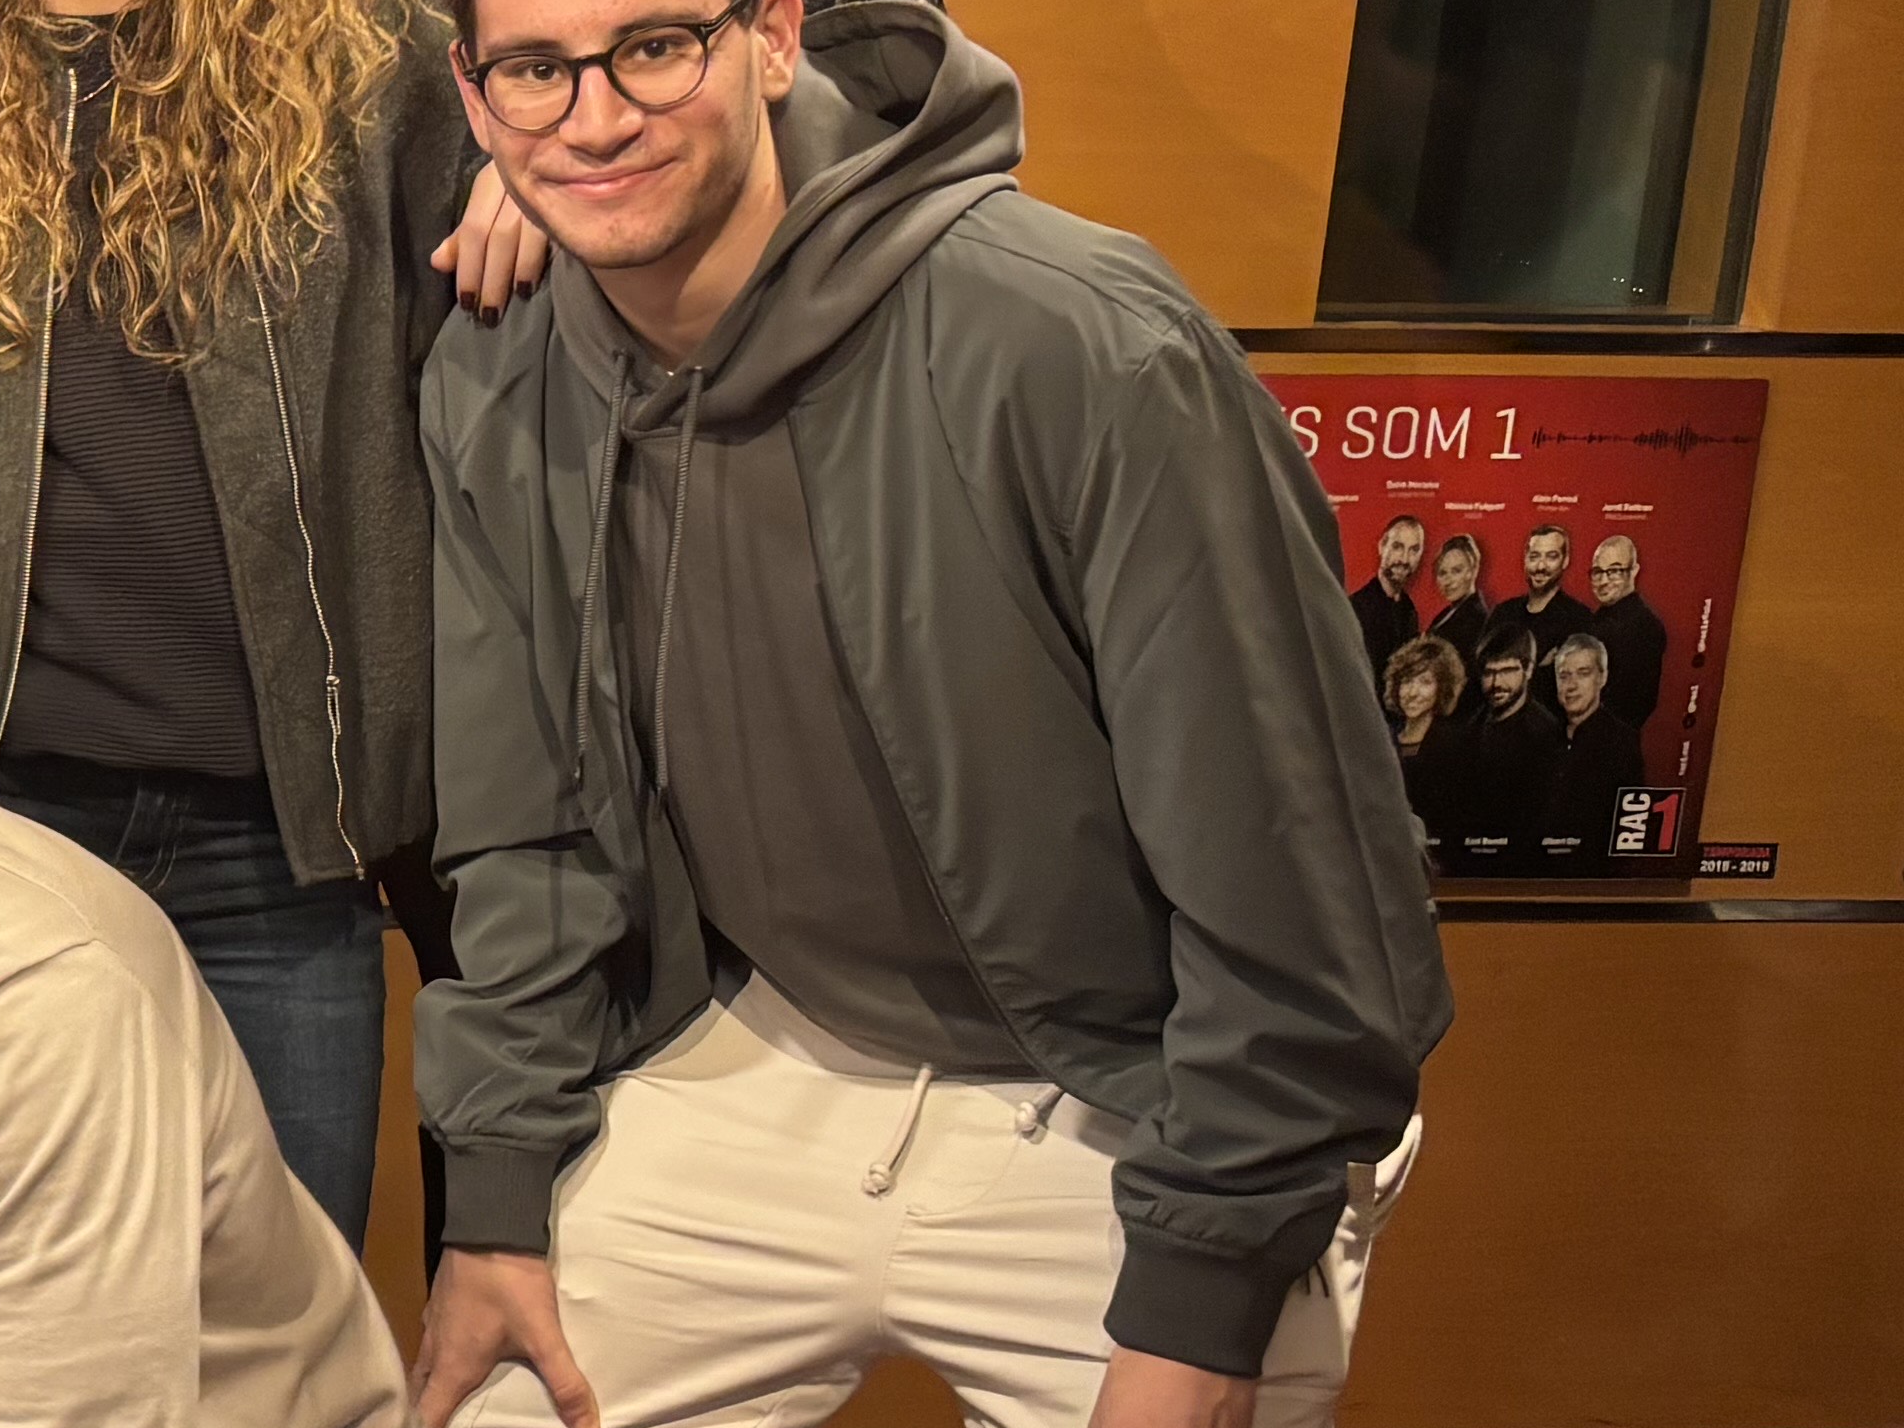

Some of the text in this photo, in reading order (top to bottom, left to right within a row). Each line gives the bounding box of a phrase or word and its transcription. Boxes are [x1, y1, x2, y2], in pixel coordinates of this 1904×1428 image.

[1342, 407, 1471, 459] SOM
[1491, 408, 1522, 459] 1
[1617, 793, 1679, 850] RAC 1
